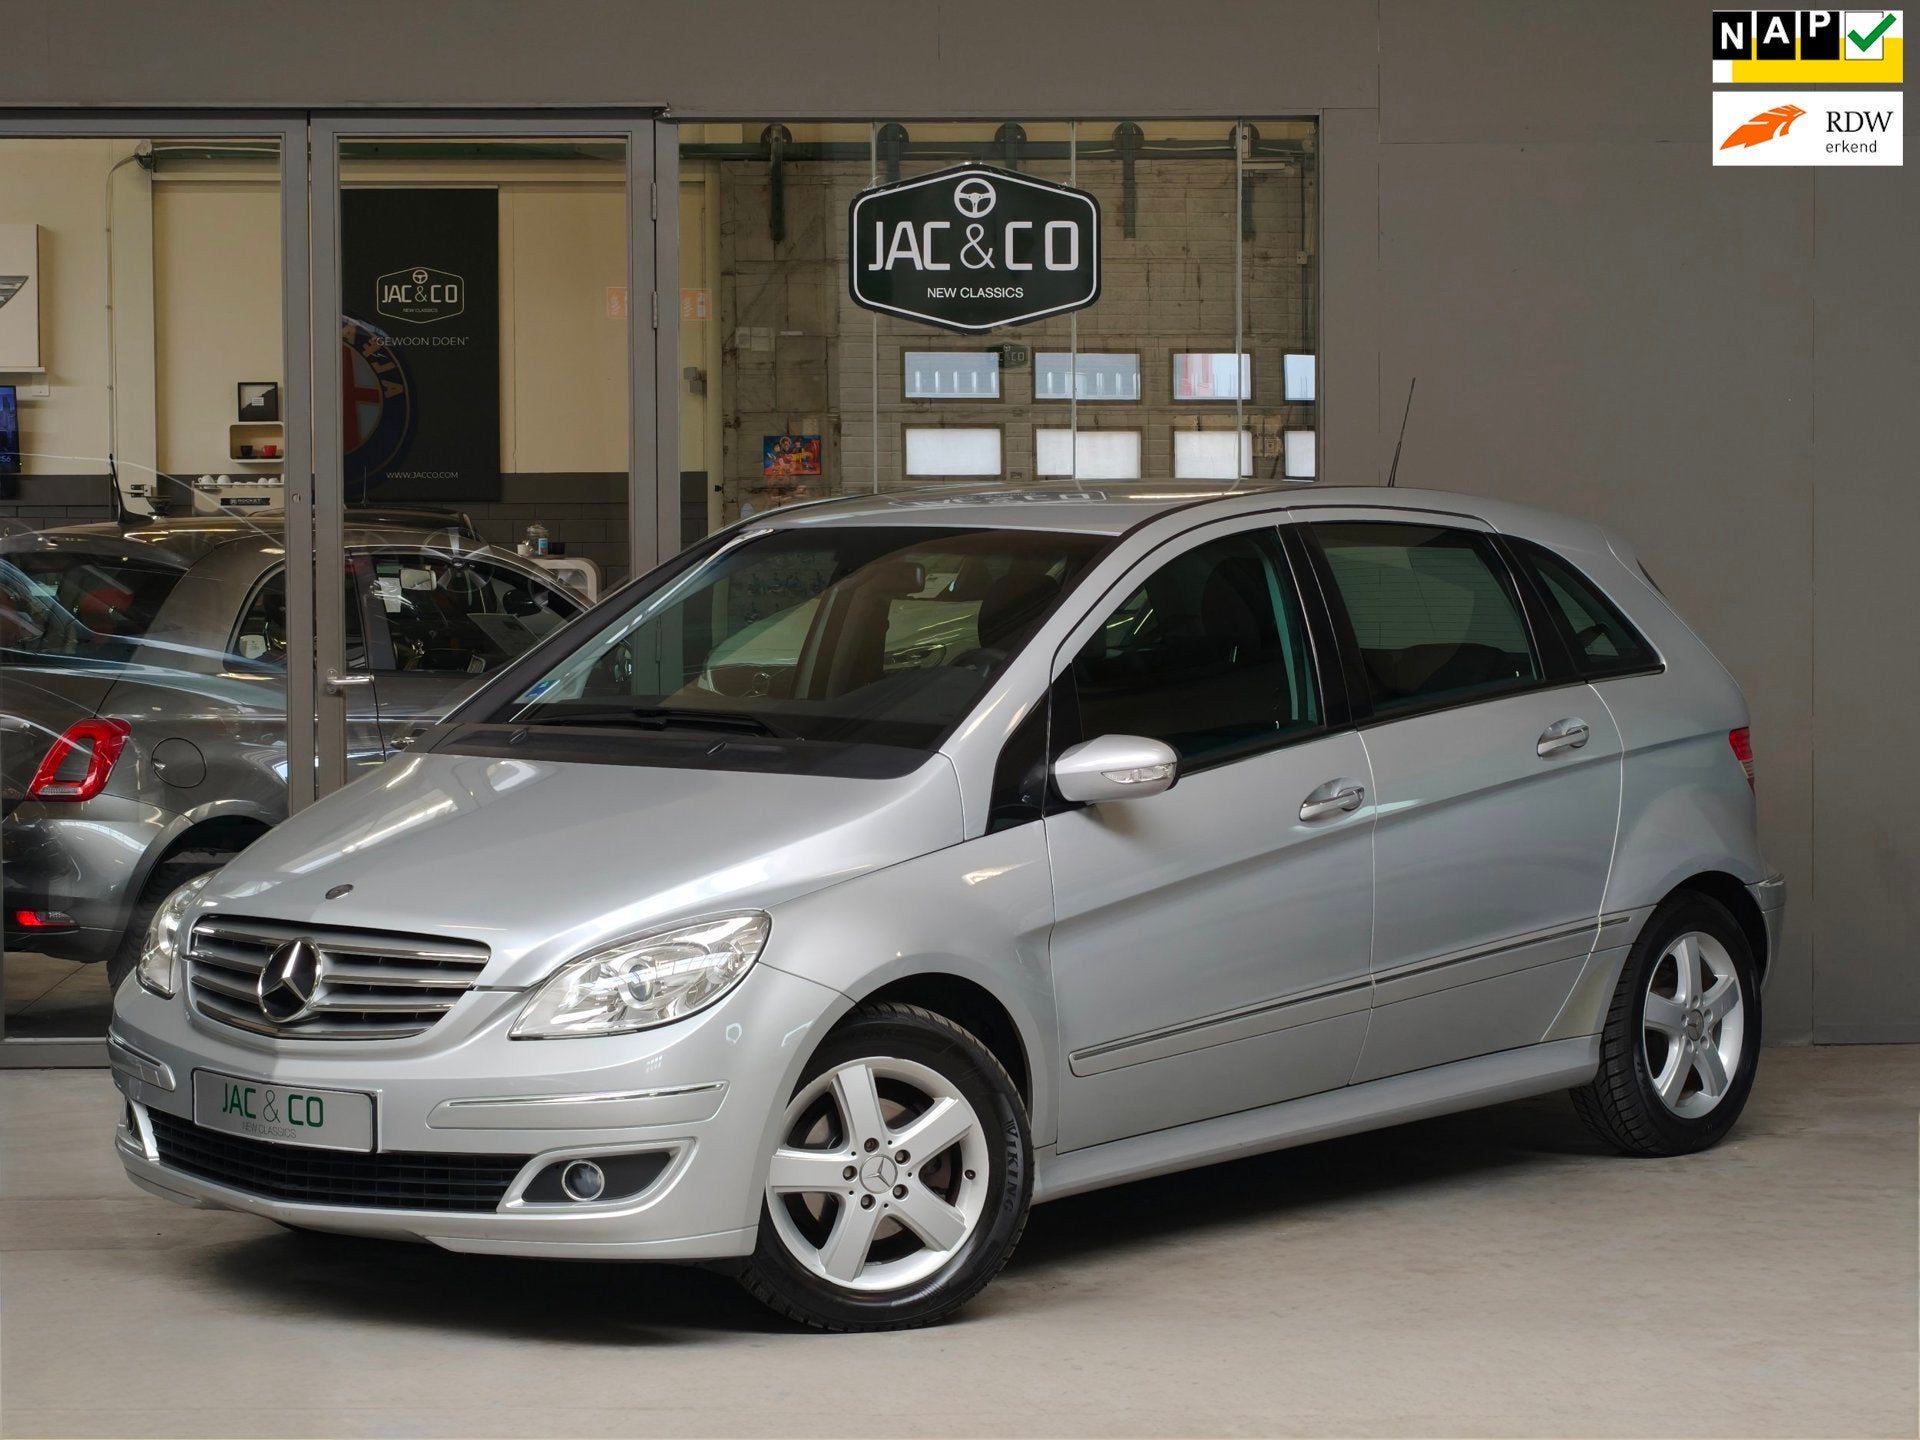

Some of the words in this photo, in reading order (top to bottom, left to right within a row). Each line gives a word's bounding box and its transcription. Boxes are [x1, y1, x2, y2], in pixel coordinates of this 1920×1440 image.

[868, 221, 951, 271] JAC
[960, 223, 996, 270] &
[1005, 220, 1079, 271] CO
[382, 285, 412, 303] JAC
[414, 286, 428, 303] &
[430, 285, 458, 303] CO
[927, 287, 957, 299] NEW
[960, 286, 1024, 299] CLASSICS
[385, 471, 459, 479] WWW.JACCO.COM
[222, 1082, 257, 1119] JAC
[262, 1089, 281, 1123] &
[288, 1093, 324, 1128] CO
[242, 1120, 258, 1134] NEW
[258, 1123, 297, 1139] CLASSICS
[1003, 1118, 1019, 1212] VIKING
